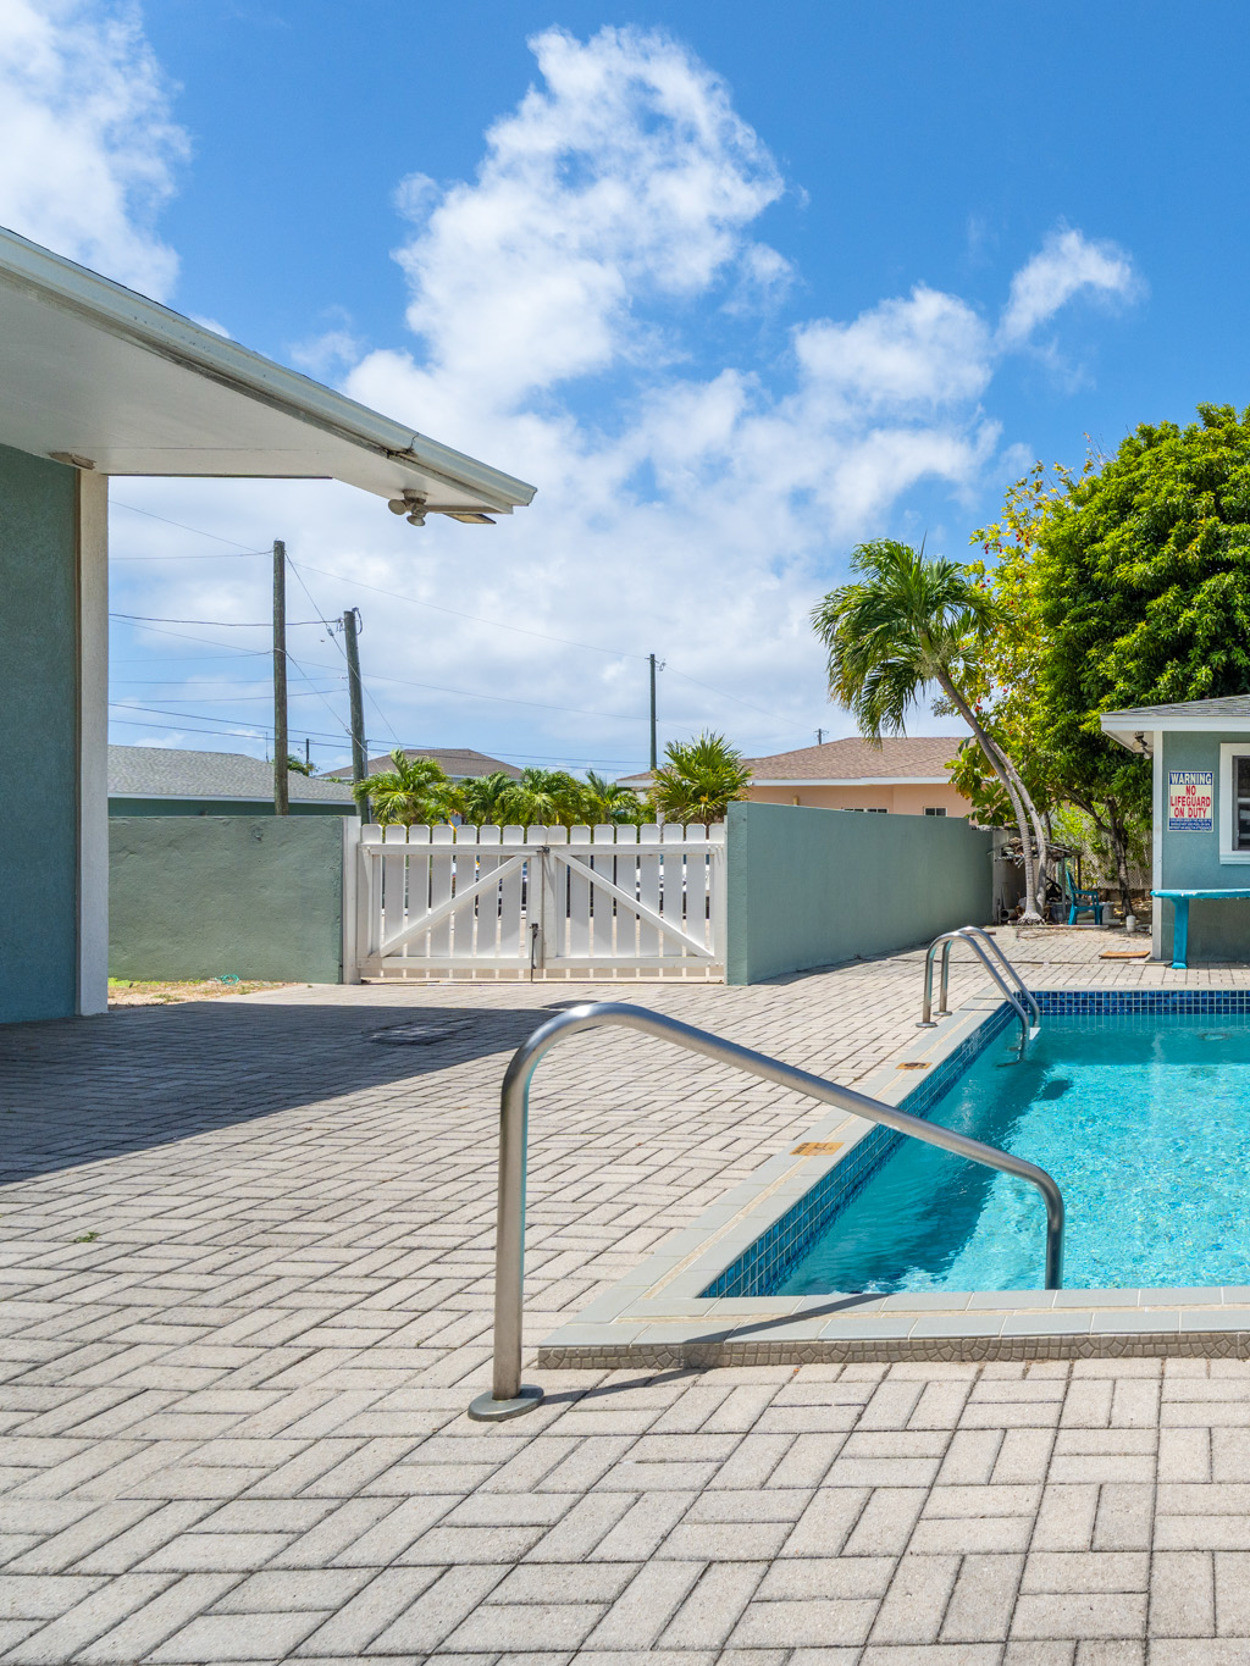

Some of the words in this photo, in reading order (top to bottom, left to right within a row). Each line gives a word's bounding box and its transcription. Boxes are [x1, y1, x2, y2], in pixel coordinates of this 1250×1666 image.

[1171, 773, 1212, 784] WARNING
[1185, 785, 1196, 796] NO
[1170, 796, 1211, 807] LIFEGUARD
[1174, 807, 1185, 818] ON
[1188, 807, 1207, 818] DUTY
